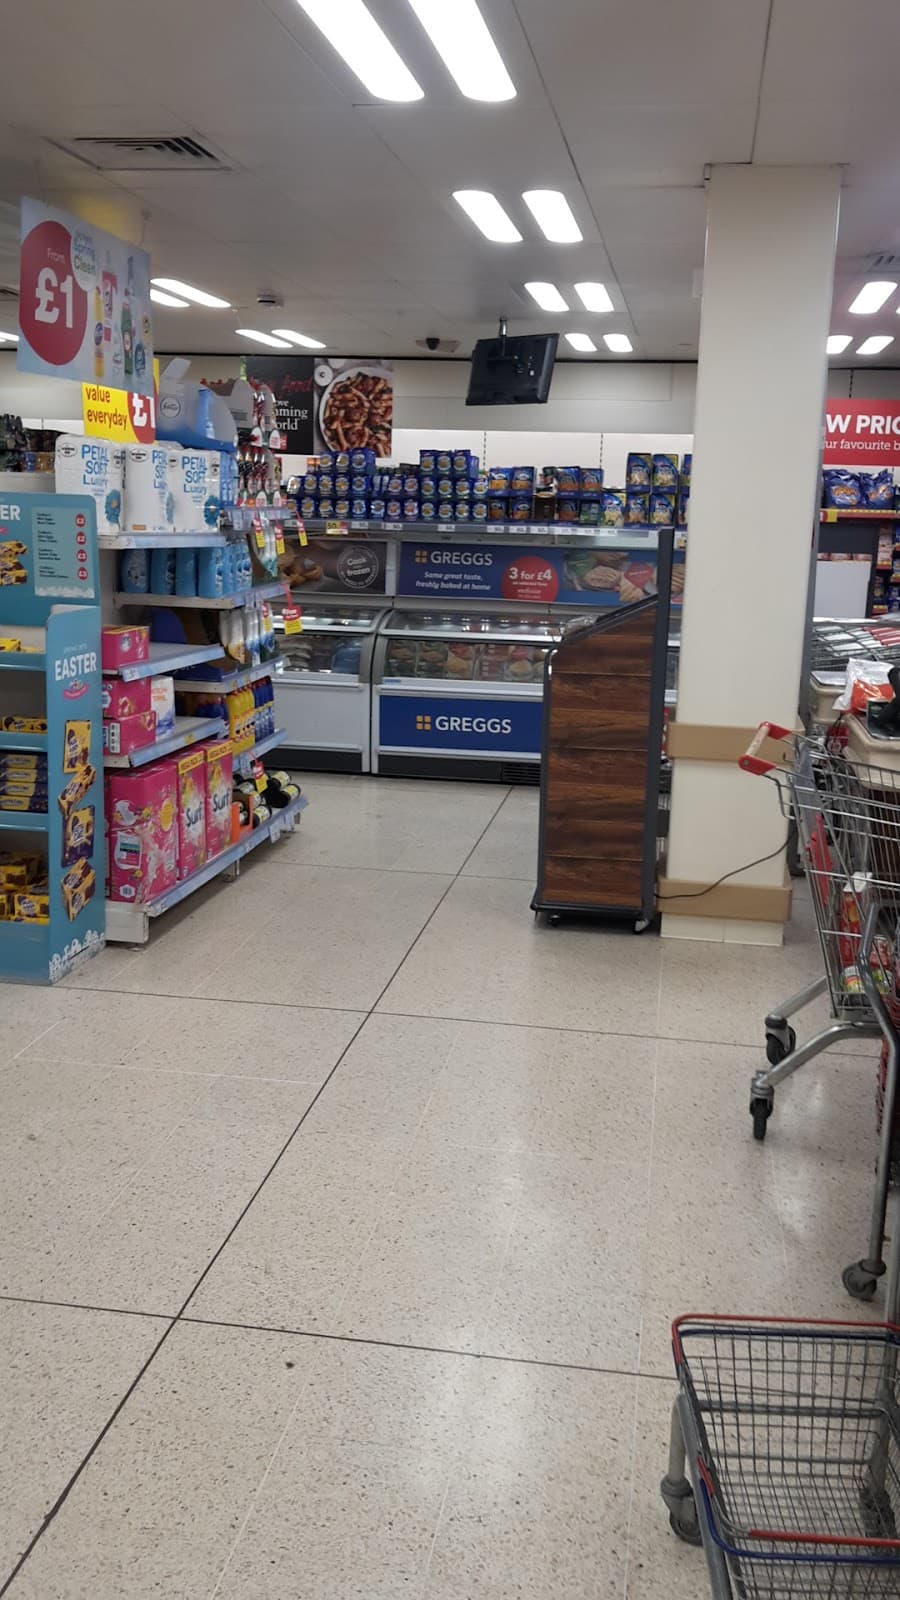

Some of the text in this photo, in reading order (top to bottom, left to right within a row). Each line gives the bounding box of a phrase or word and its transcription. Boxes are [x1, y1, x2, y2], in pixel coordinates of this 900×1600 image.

[47, 248, 65, 264] From
[35, 267, 73, 329] £1
[85, 385, 111, 403] value
[132, 392, 156, 430] £1
[275, 406, 308, 420] ming
[87, 408, 128, 431] everyday
[276, 418, 299, 431] orld
[826, 414, 852, 434] W
[825, 440, 838, 449] ur
[840, 439, 891, 450] favourite
[81, 444, 110, 462] PETAL
[85, 460, 108, 475] SOFT
[182, 456, 208, 471] PETAL
[185, 470, 207, 484] SOFT
[0, 505, 20, 521] ER
[430, 551, 493, 567] GREGGS
[444, 573, 462, 582] great
[509, 567, 552, 582] 3 for £4
[415, 580, 439, 590] freshly
[441, 581, 461, 590] baked
[472, 582, 491, 591] home
[54, 651, 97, 681] EASTER
[435, 716, 512, 734] GREGGS
[213, 788, 231, 813] Surf
[186, 805, 202, 828] Surf
